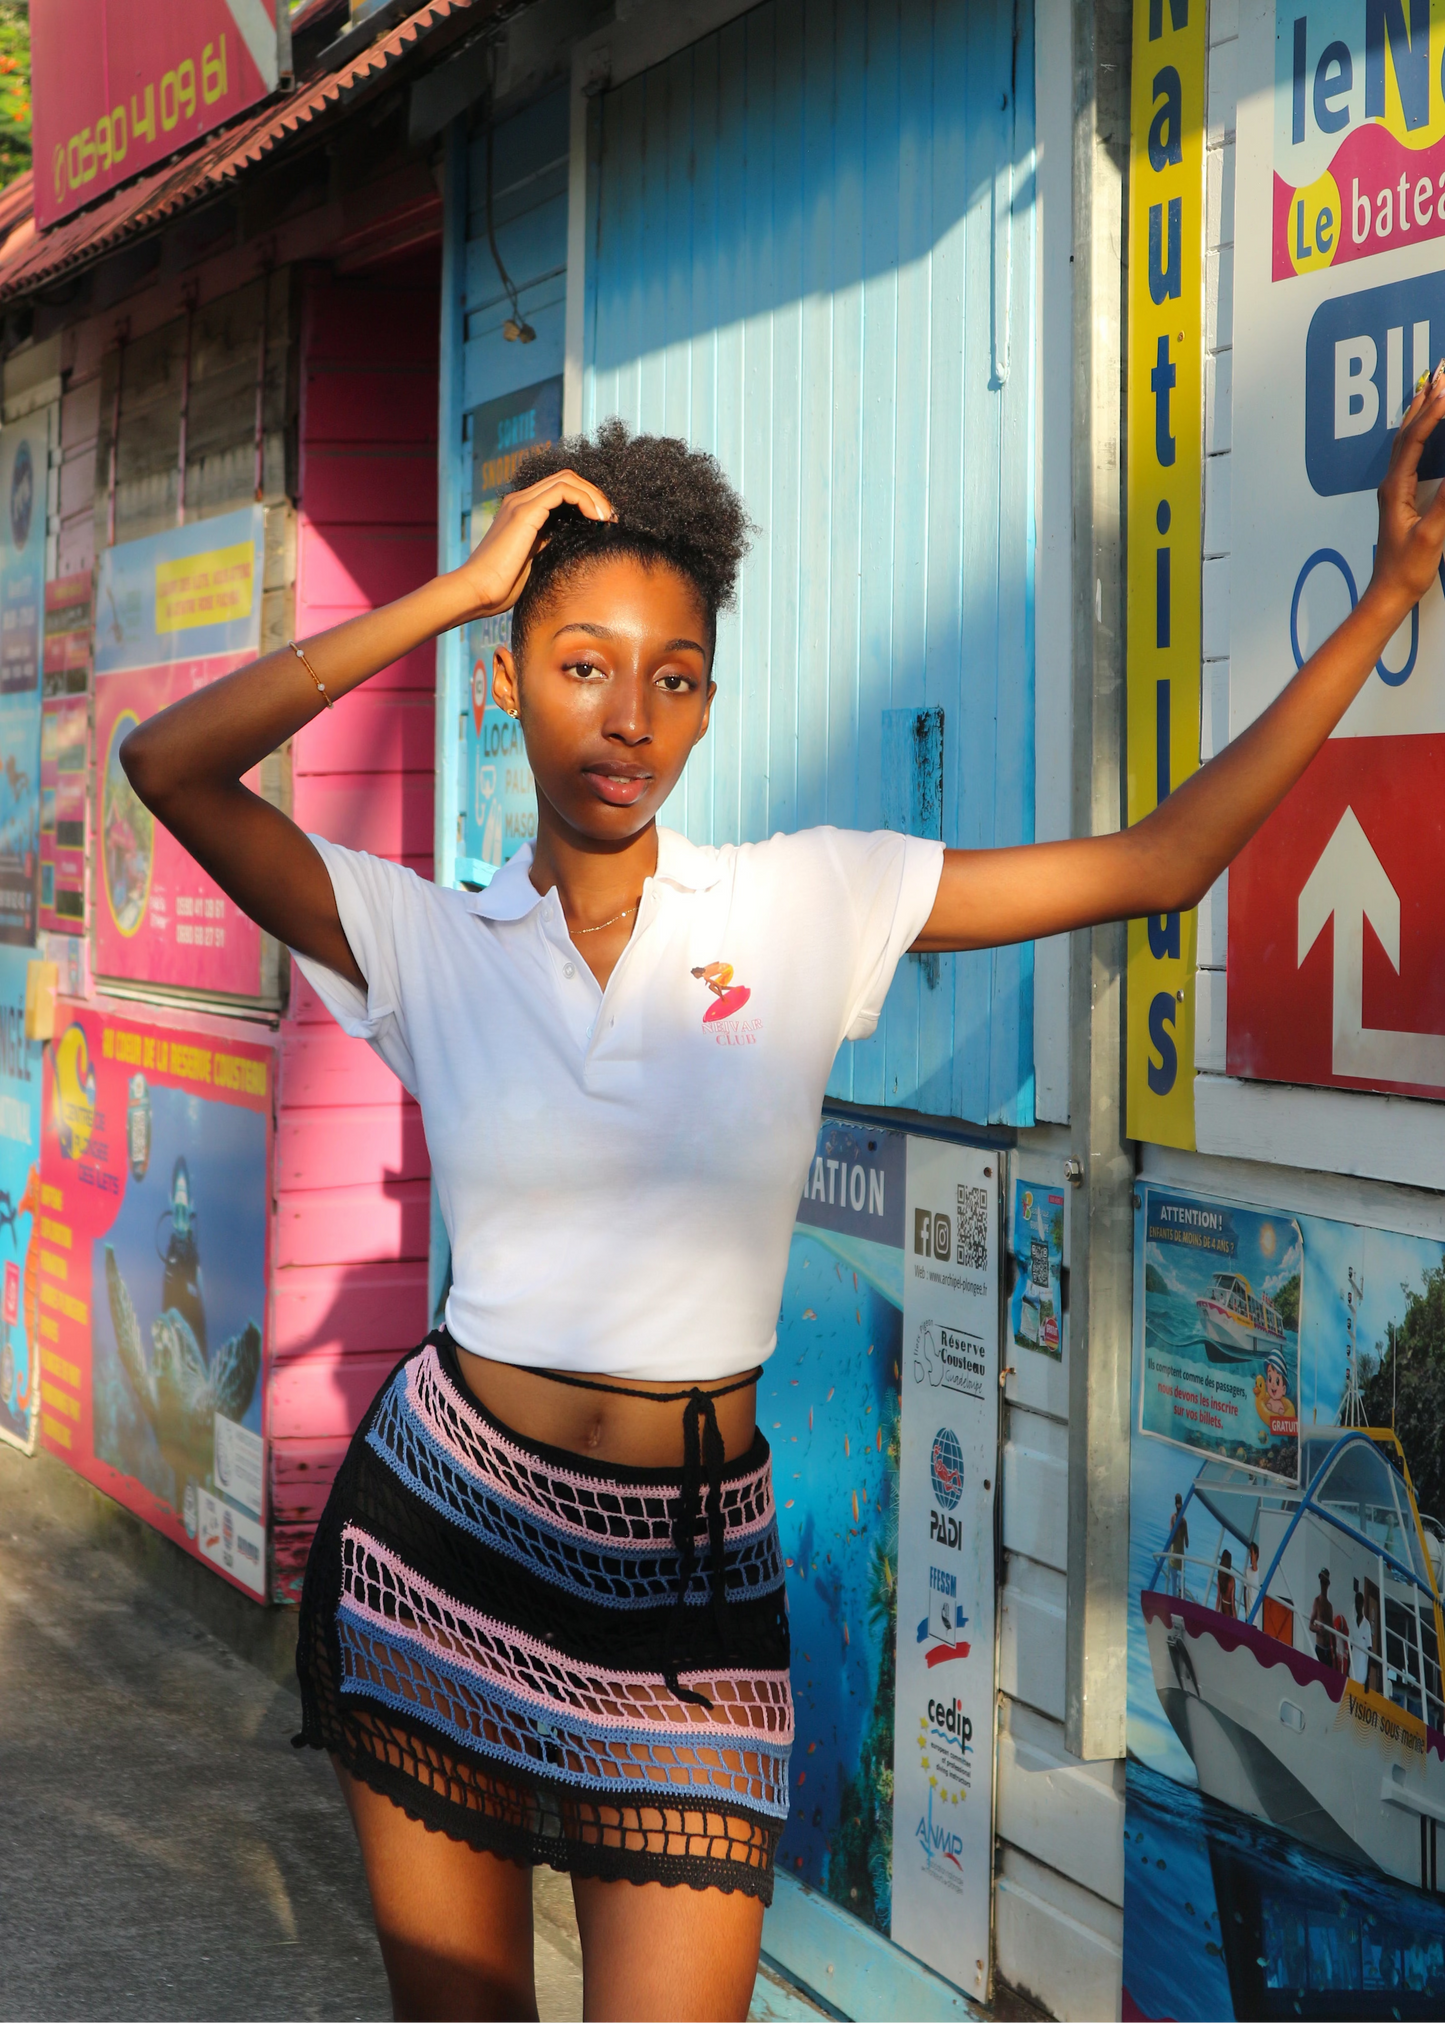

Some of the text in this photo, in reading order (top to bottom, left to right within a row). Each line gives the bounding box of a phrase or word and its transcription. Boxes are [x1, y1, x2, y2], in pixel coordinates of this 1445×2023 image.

[160, 58, 196, 132] 09
[202, 33, 228, 105] 61
[1297, 200, 1334, 259] Le
[1291, 544, 1445, 687] OU
[505, 812, 538, 840] MASQ
[716, 1032, 757, 1046] CLUB
[1149, 1226, 1173, 1241] ENFANTS
[1174, 1229, 1182, 1243] DE
[1182, 1231, 1202, 1247] MOINS
[1203, 1235, 1211, 1249] DE
[1216, 1239, 1230, 1254] ANS
[914, 1265, 925, 1279] Web
[929, 1272, 988, 1297] www.archipel-plongee.fr
[940, 1348, 986, 1376] Cousteau
[941, 1331, 986, 1358] Réserve
[1148, 1357, 1247, 1400] Ils comptent comme des passagers,
[1157, 1382, 1239, 1417] nous devons les inscrire
[1173, 1403, 1224, 1430] sur vos billets.
[930, 1509, 962, 1551] PADI
[930, 1565, 957, 1599] FFESSM
[928, 1697, 973, 1755] cedip
[1348, 1692, 1378, 1728] Vision
[1380, 1715, 1400, 1740] sous
[915, 1816, 963, 1856] ANMP
